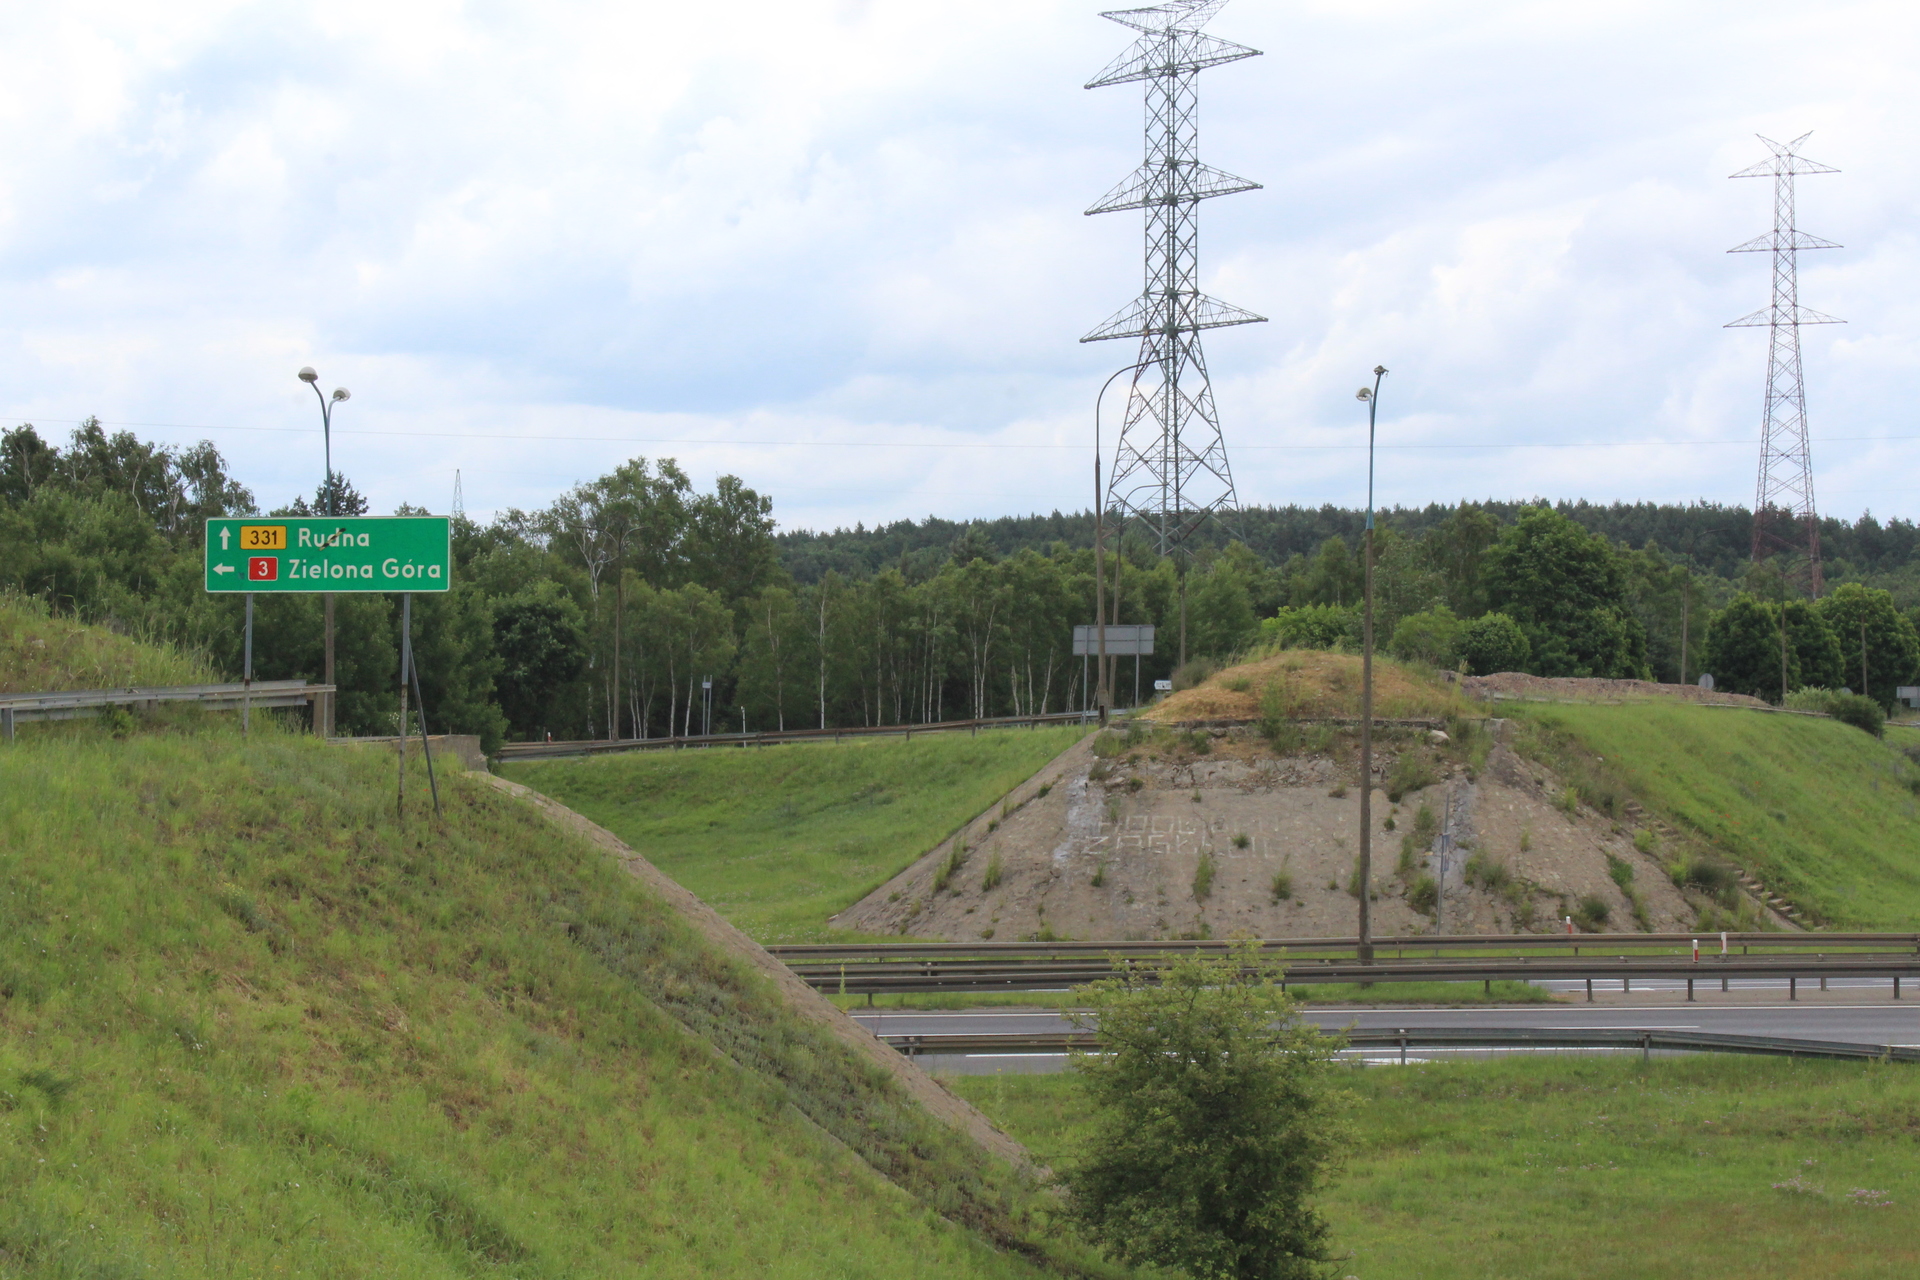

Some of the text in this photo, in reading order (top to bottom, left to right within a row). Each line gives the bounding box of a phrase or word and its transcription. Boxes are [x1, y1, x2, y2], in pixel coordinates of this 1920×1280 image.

[250, 527, 370, 547] 331 Rudna
[257, 558, 441, 579] 3 Zielona Góra
